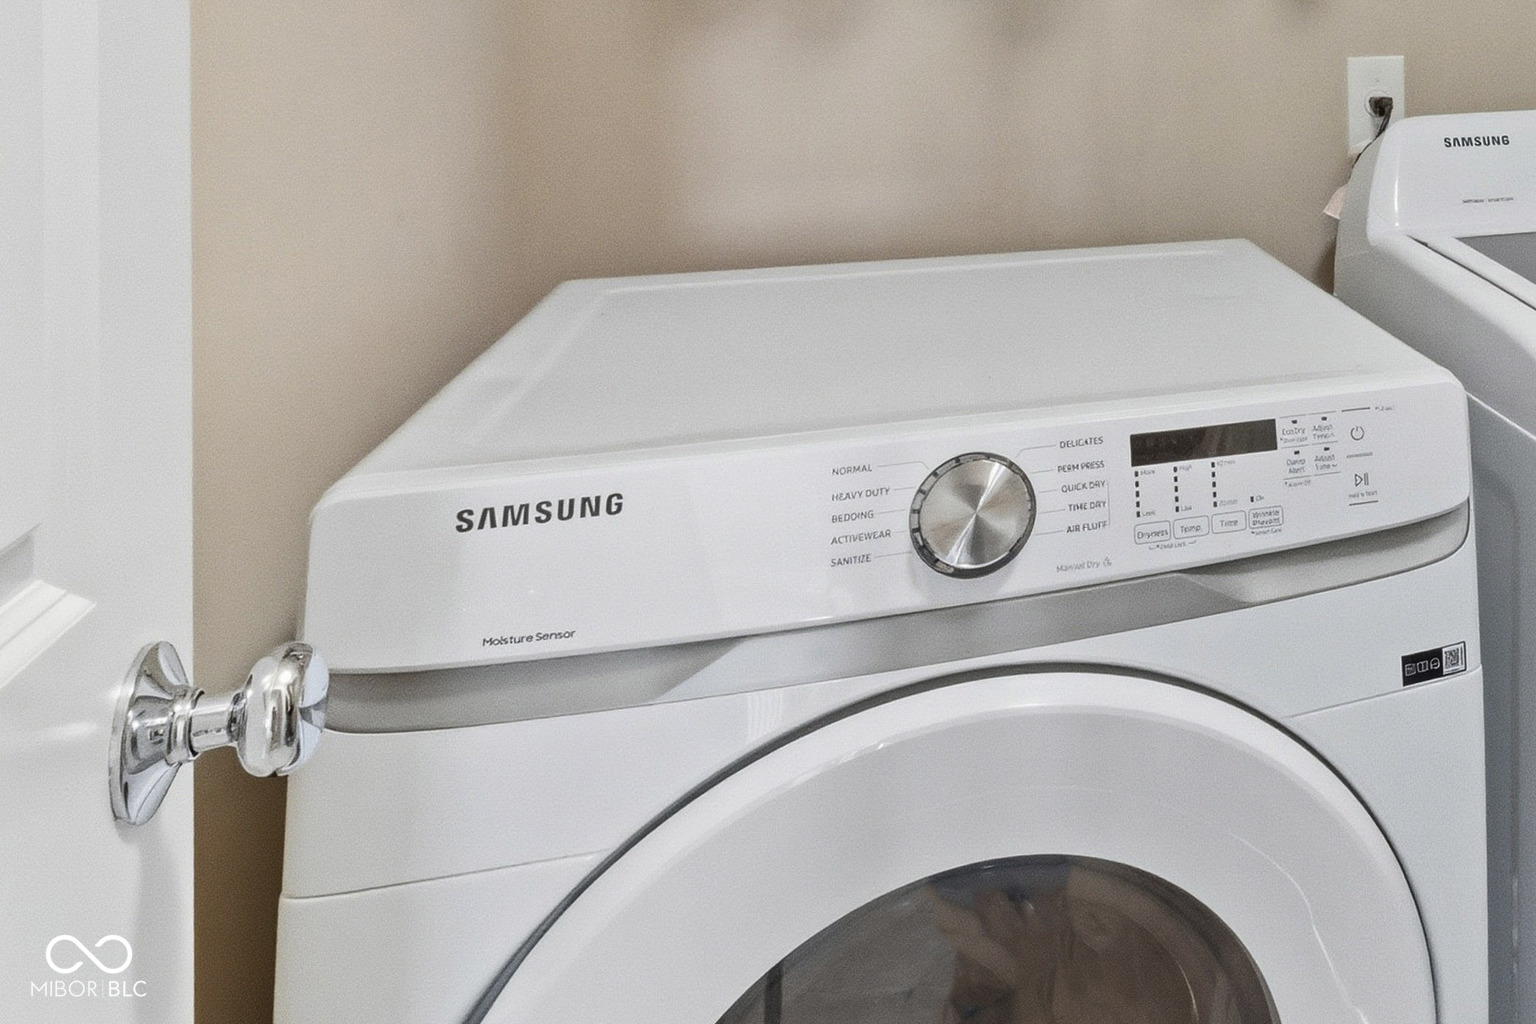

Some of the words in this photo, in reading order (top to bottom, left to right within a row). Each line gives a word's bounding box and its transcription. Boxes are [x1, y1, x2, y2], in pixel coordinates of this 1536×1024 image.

[1444, 135, 1510, 148] SAMSUNG
[831, 463, 873, 476] NORMAL
[831, 489, 863, 502] HEAVY
[865, 486, 891, 498] DUTY
[455, 492, 624, 533] SAMSUNG
[831, 509, 875, 524] BEDDING
[1066, 523, 1081, 534] AIR
[830, 528, 892, 546] ACTIVEWEAR
[830, 552, 872, 568] SANITIZE
[482, 634, 534, 647] Moisture
[535, 630, 577, 642] Sensor
